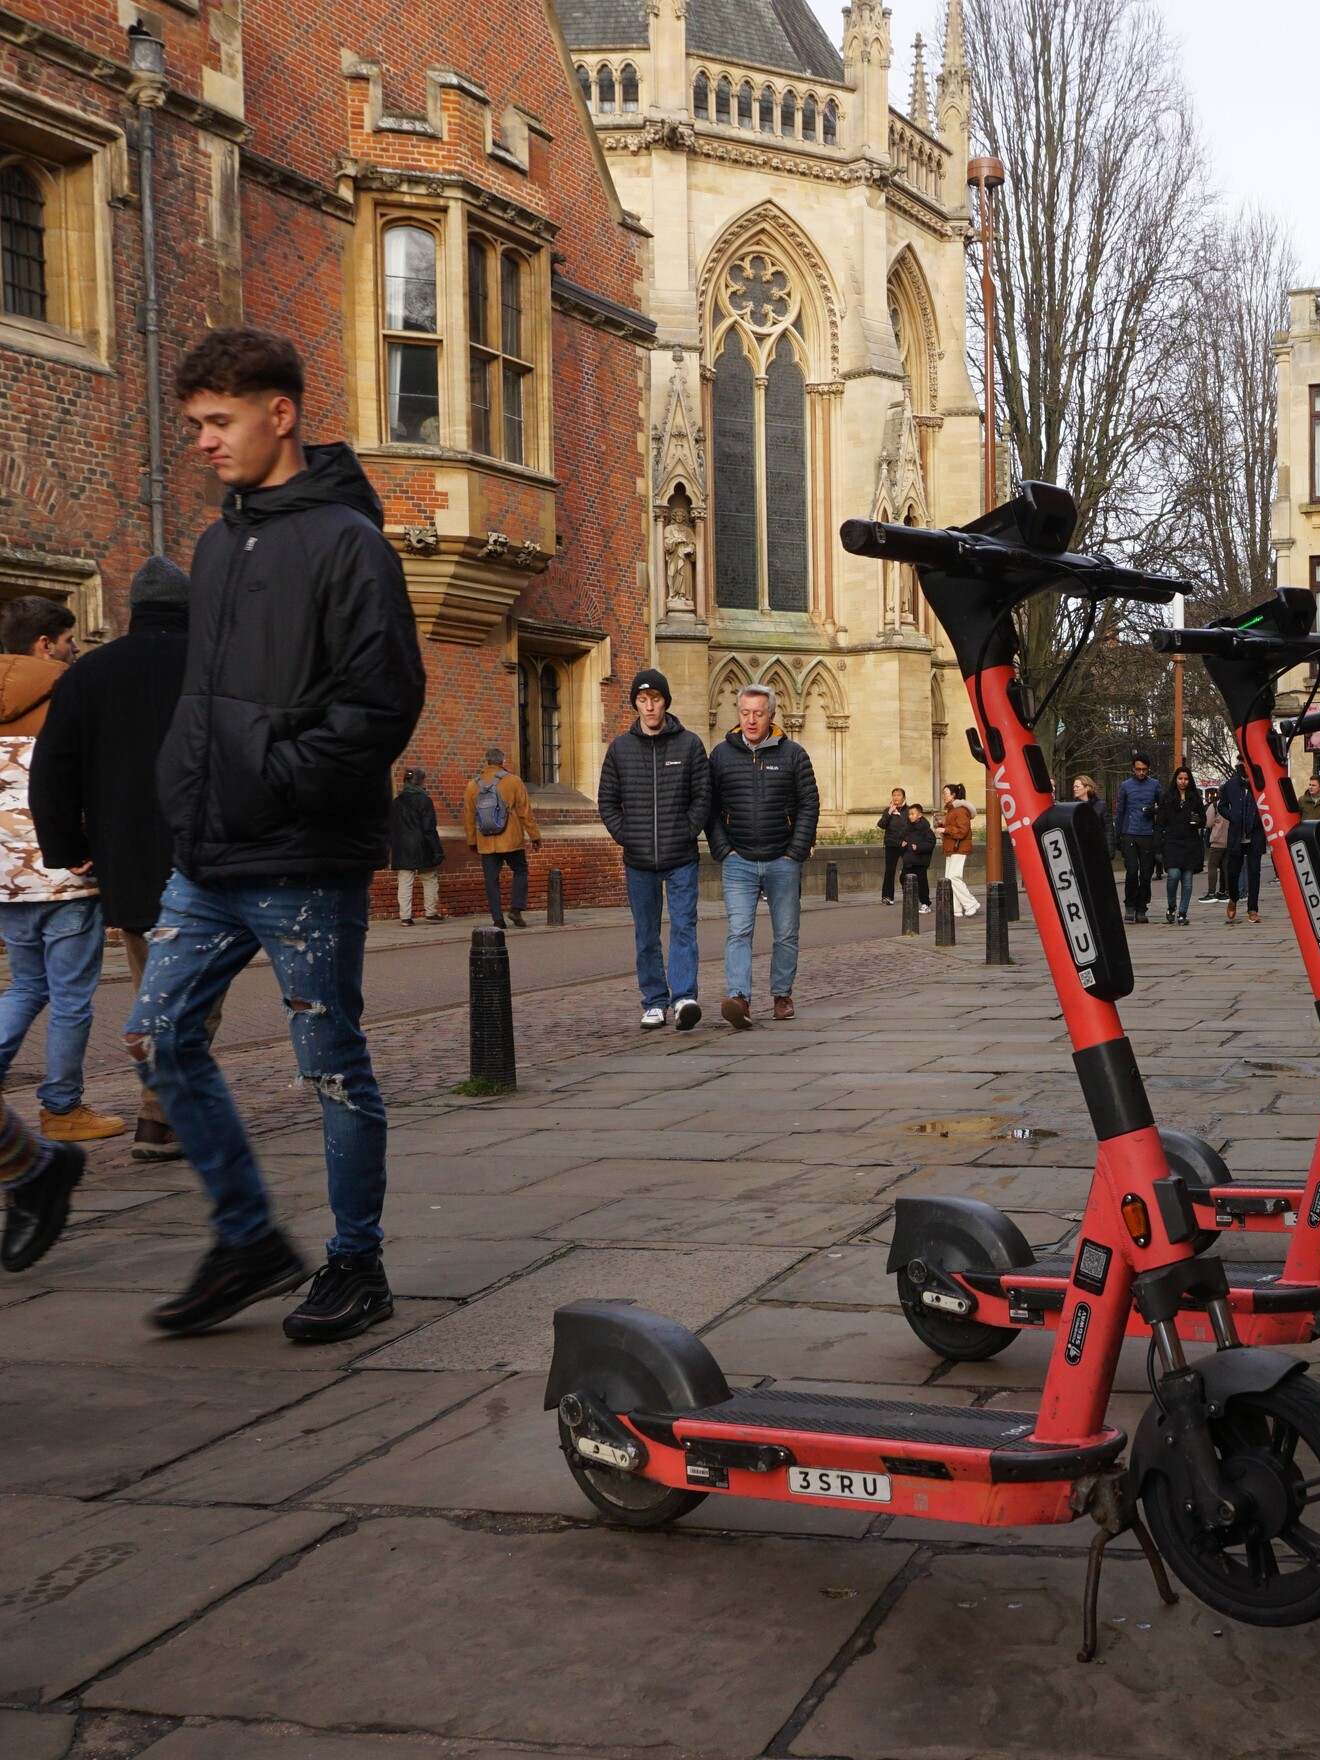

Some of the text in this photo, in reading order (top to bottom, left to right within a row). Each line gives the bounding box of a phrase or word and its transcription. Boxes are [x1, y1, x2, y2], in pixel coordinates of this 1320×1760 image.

[1049, 839, 1091, 954] 3SRU
[1075, 1310, 1087, 1345] SEGWAY
[799, 1471, 878, 1497] 3SRU
